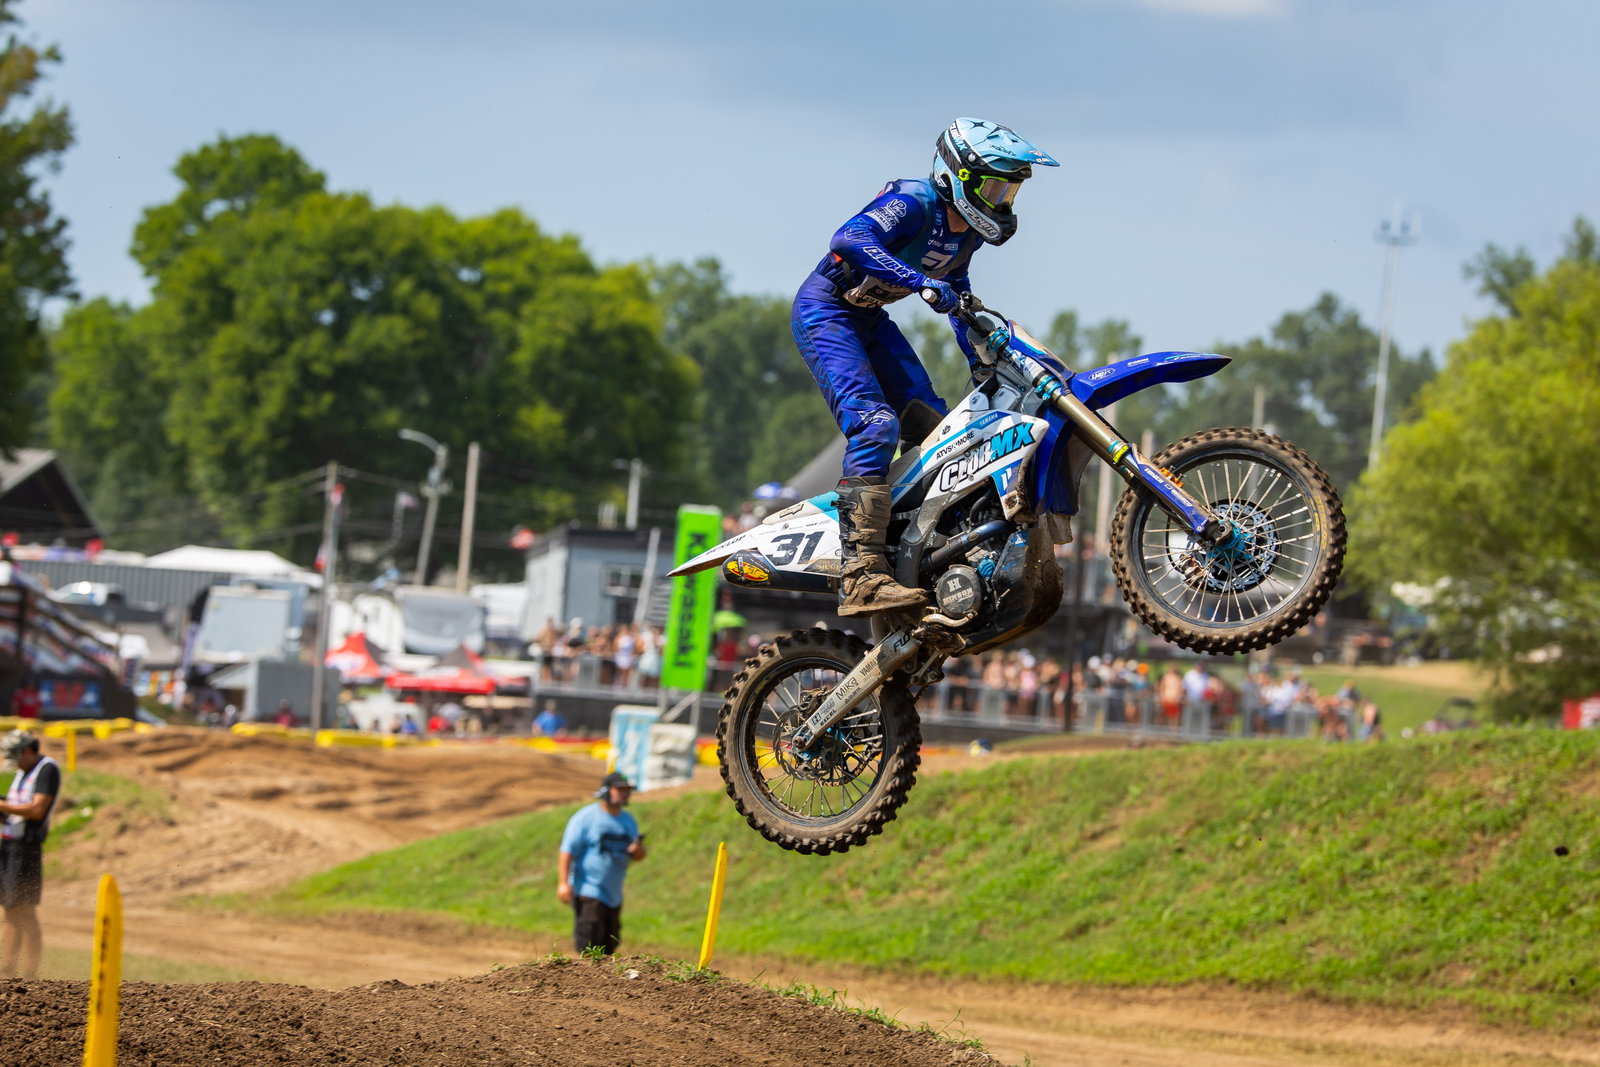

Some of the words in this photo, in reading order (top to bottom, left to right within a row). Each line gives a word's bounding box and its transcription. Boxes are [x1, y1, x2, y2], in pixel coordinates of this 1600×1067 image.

[940, 422, 1036, 492] CLUBMX
[765, 530, 826, 567] 31
[675, 532, 708, 666] Kwasaki
[942, 587, 973, 604] HINSON
[946, 577, 962, 593] H
